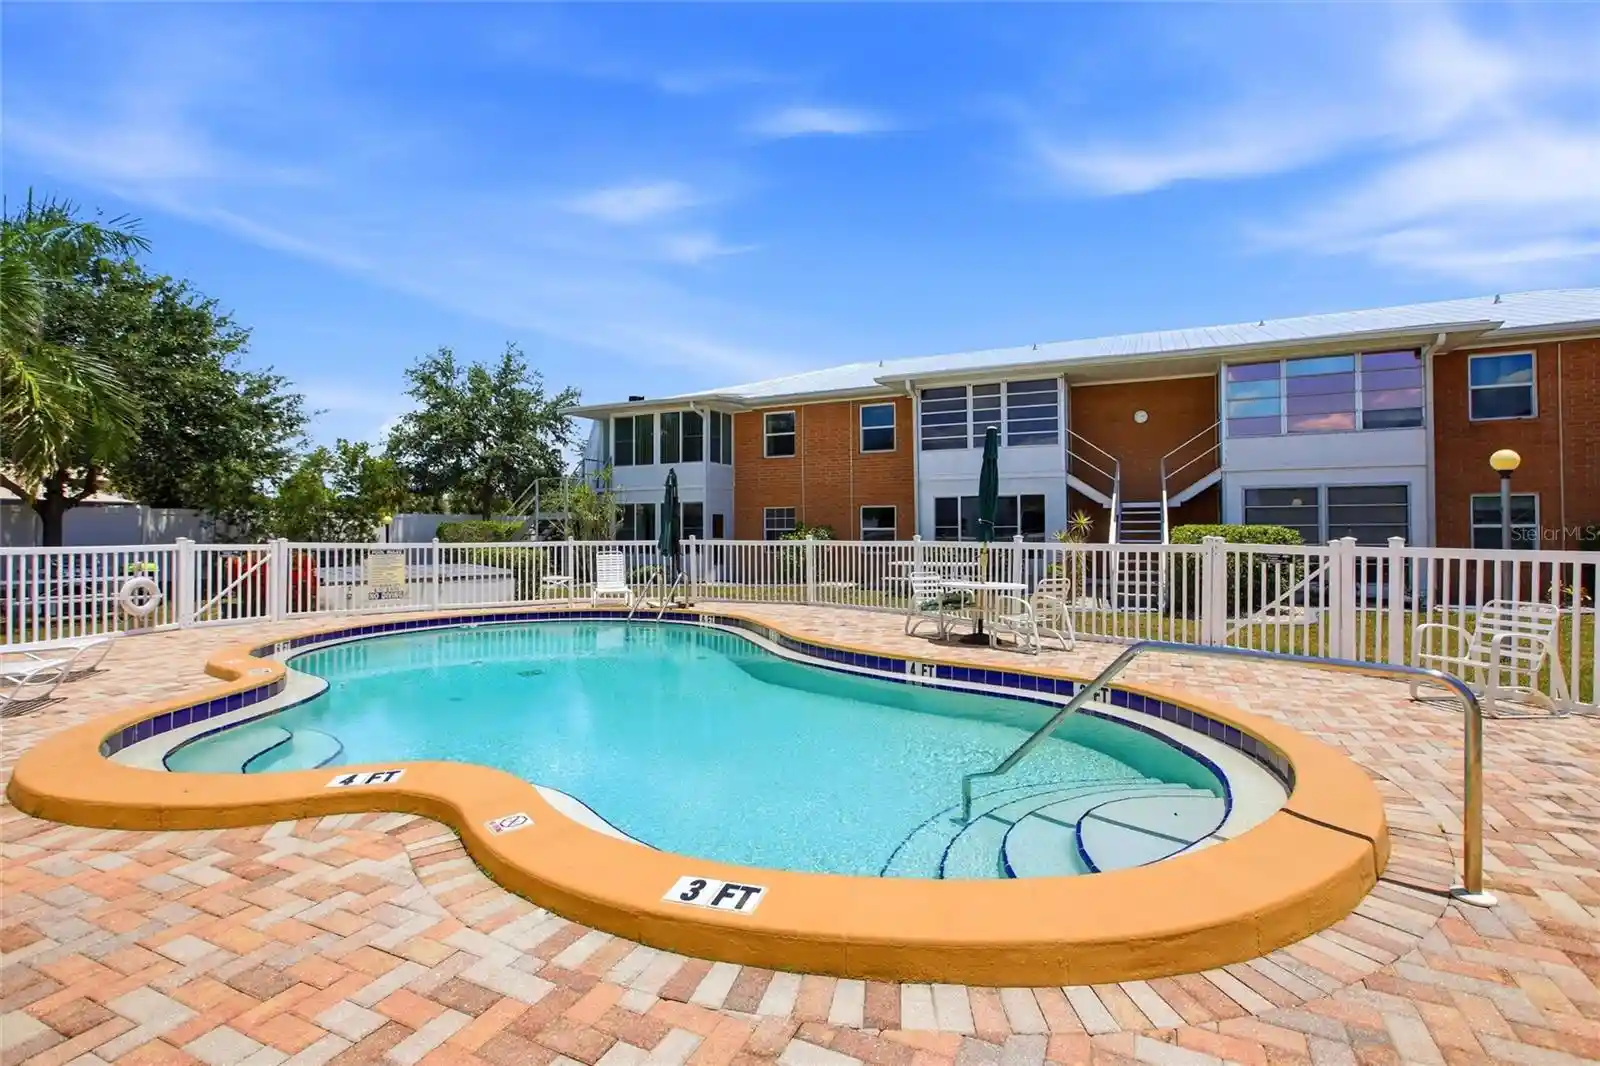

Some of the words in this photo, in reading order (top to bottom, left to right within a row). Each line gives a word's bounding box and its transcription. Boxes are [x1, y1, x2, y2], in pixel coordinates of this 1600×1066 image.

[910, 661, 917, 675] 4
[921, 663, 935, 678] FT
[339, 774, 358, 786] 4
[365, 770, 402, 785] FT
[680, 879, 707, 901] 3
[710, 883, 762, 910] FT
